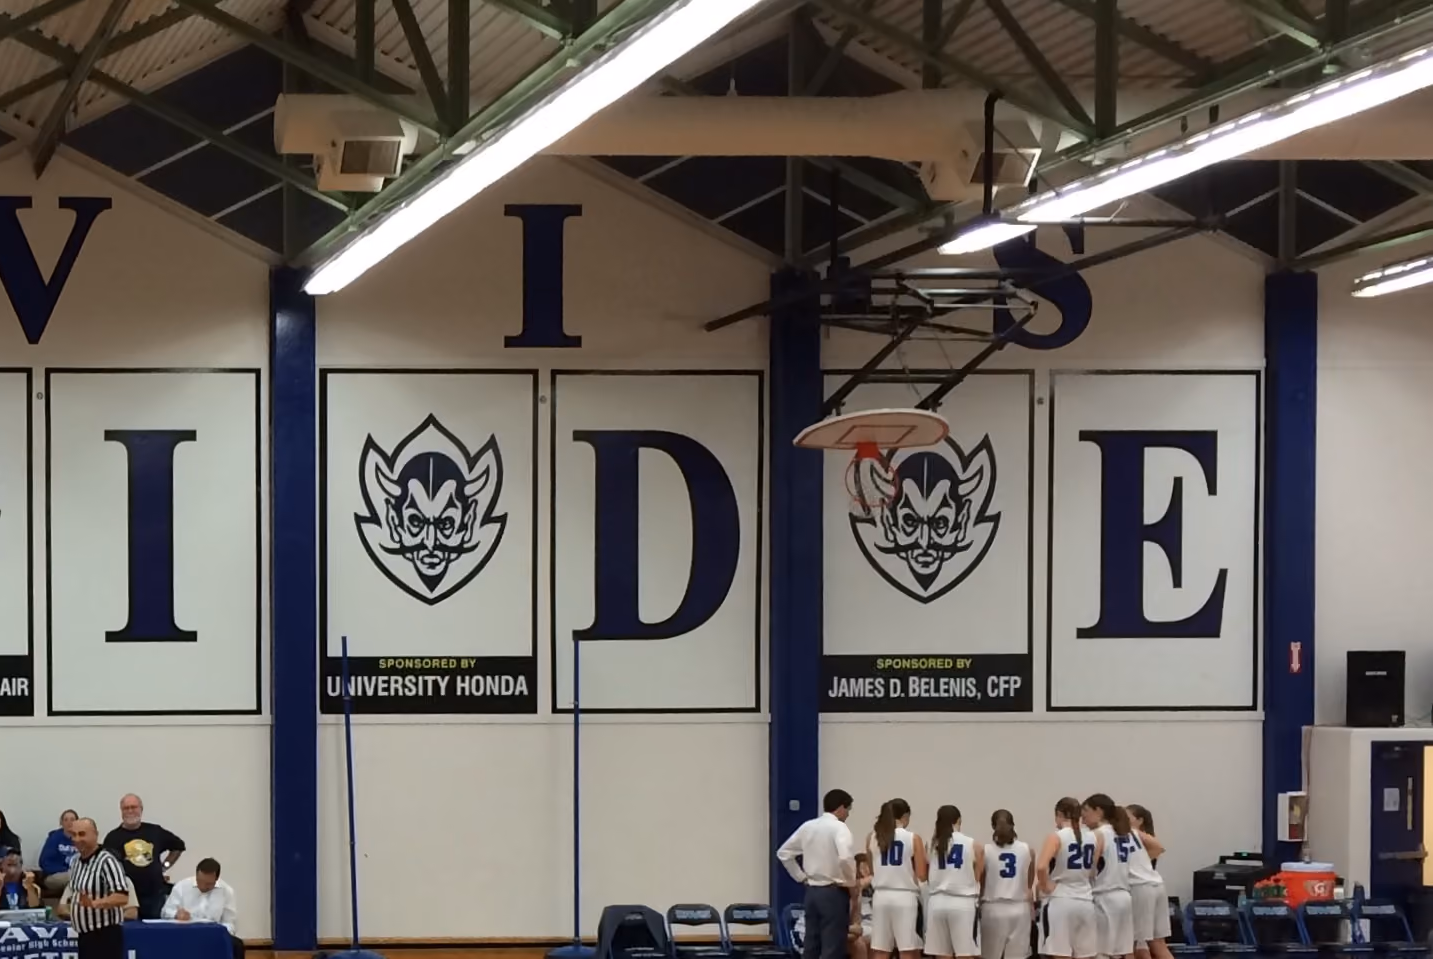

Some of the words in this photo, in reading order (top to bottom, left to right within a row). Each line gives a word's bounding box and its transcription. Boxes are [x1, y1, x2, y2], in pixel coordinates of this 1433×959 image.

[504, 204, 582, 348] I
[993, 212, 1093, 350] S
[104, 430, 197, 643] I
[572, 430, 741, 640] D
[1076, 430, 1228, 639] E
[379, 658, 457, 669] SPONSORED
[460, 658, 477, 668] BY
[876, 658, 953, 669] SPONSORED
[956, 658, 972, 669] BY
[0, 677, 29, 697] AIR
[327, 675, 450, 696] UNIVERSITY
[456, 675, 529, 696] HONDA
[828, 676, 885, 698] JAMES
[889, 678, 905, 698] D.
[908, 676, 981, 700] BELENIS,
[987, 675, 1022, 697] CFP
[999, 853, 1016, 878] 3
[1067, 844, 1095, 869] 20
